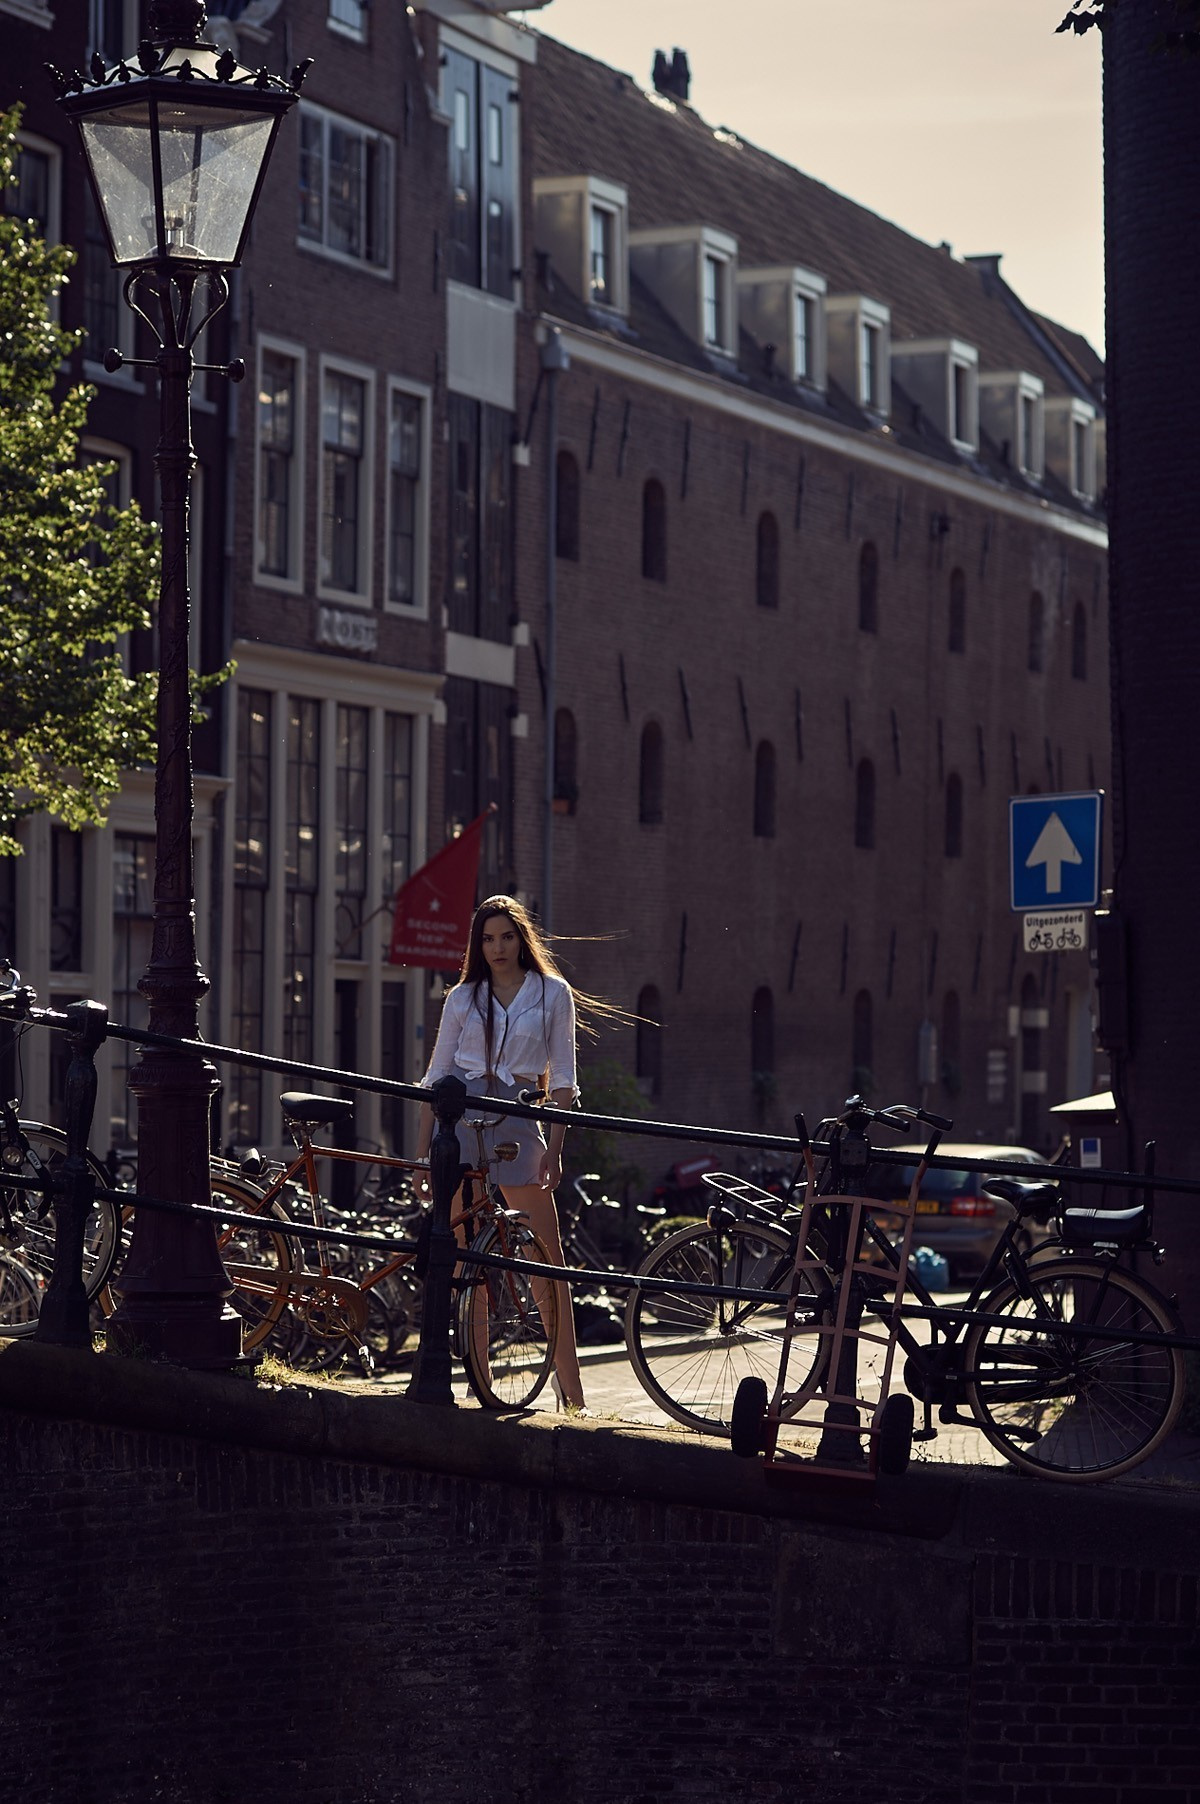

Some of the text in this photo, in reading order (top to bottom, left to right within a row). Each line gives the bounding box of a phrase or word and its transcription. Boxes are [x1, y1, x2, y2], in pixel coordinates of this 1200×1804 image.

[407, 917, 459, 933] SECOND
[1026, 913, 1083, 928] Uitgezonderd
[416, 932, 446, 945] NEW
